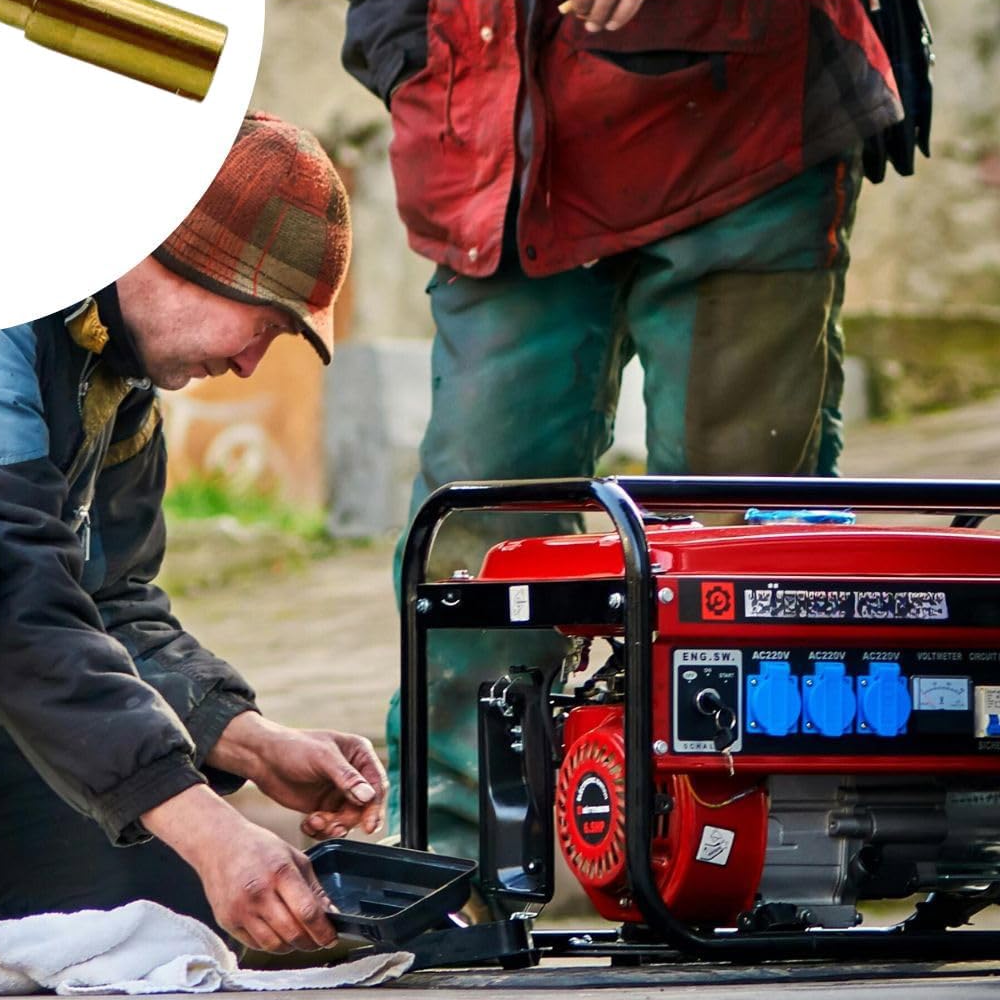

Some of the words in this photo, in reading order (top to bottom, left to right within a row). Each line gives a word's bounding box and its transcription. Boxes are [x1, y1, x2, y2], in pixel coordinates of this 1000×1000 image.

[683, 651, 735, 661] ENG.SW.
[752, 651, 790, 660] AC220V
[808, 651, 846, 660] AC220V
[862, 651, 900, 660] AC220V
[916, 652, 962, 661] VOLTMETER
